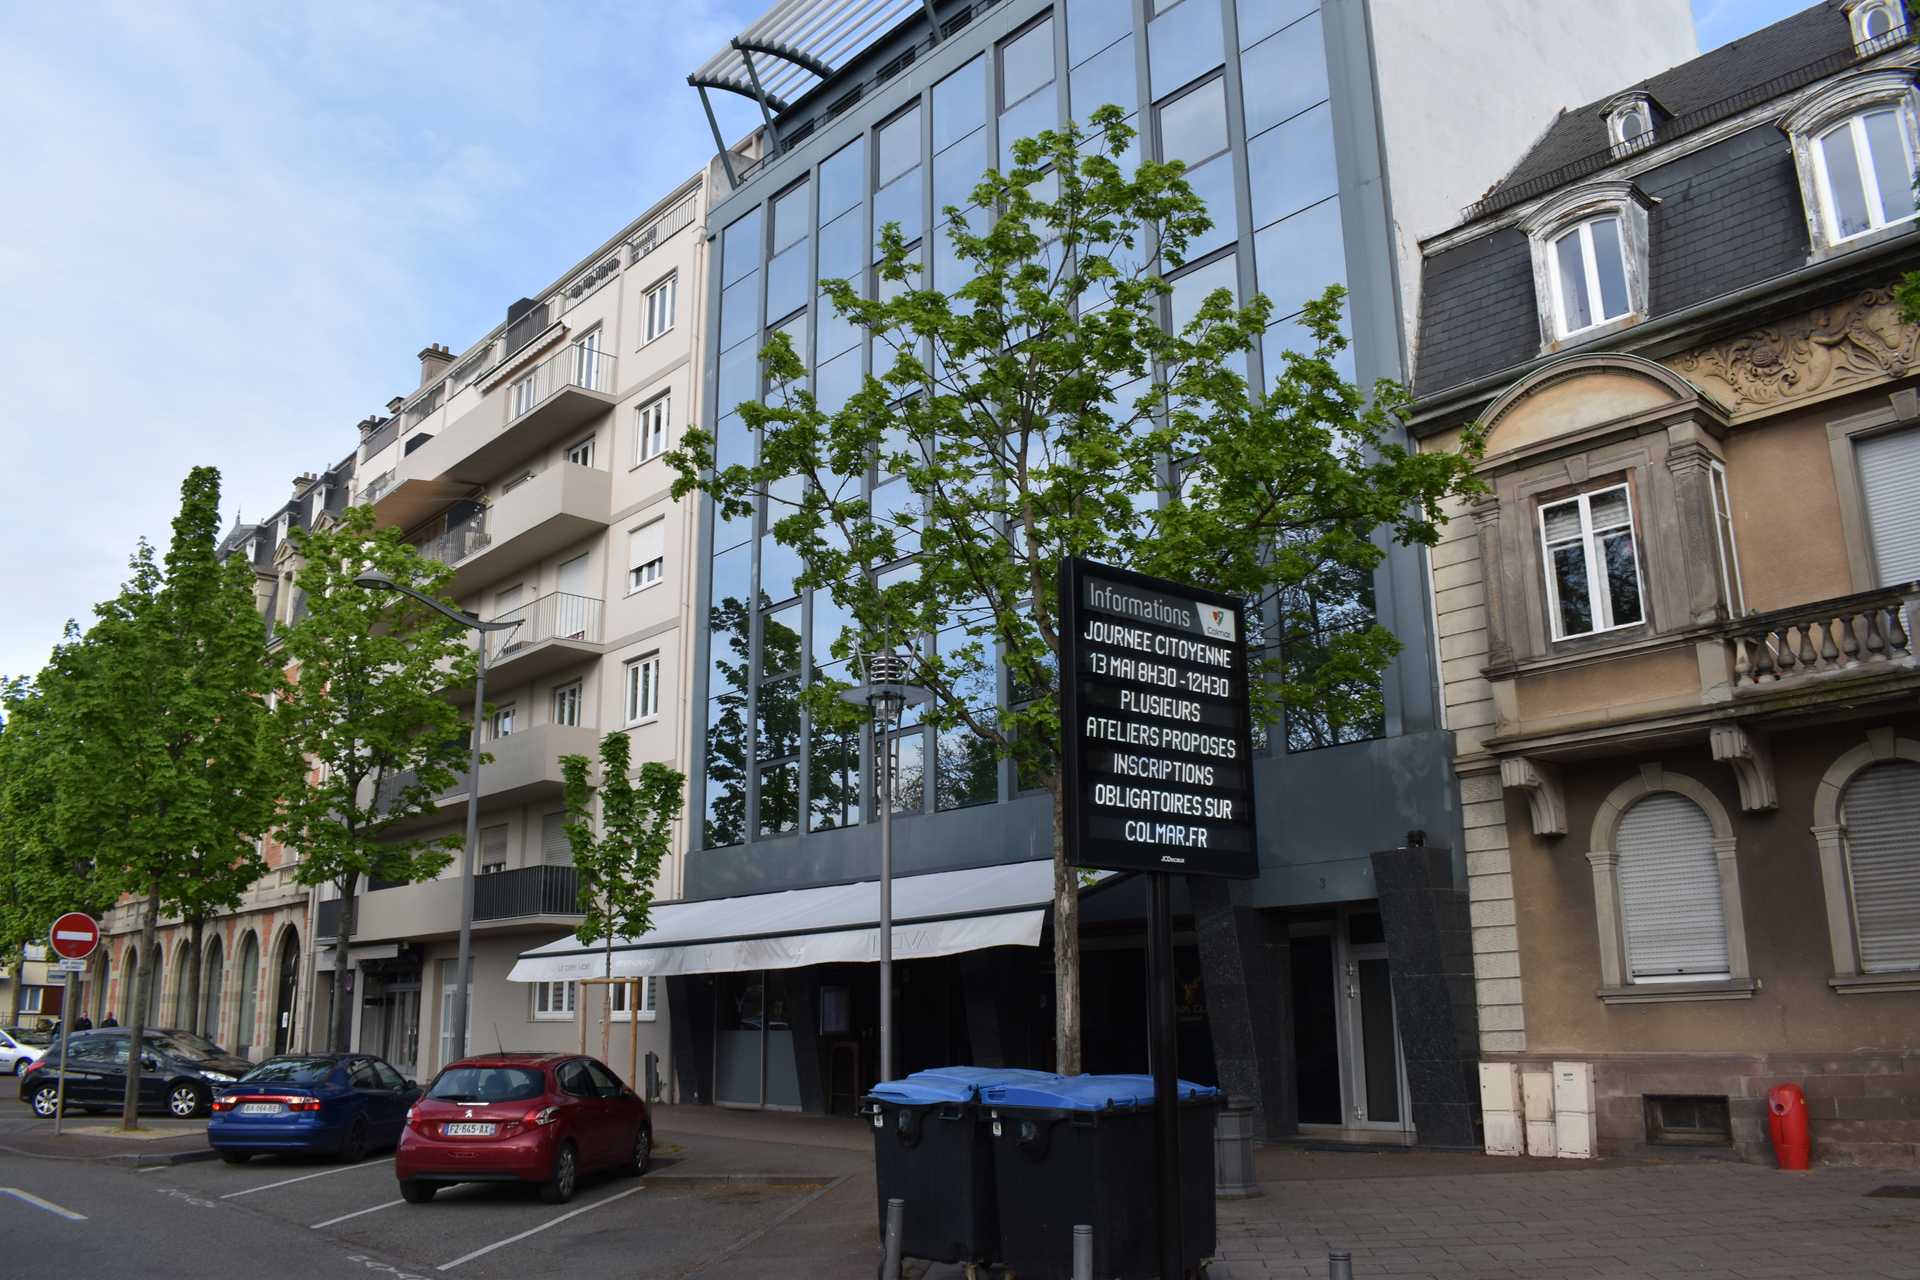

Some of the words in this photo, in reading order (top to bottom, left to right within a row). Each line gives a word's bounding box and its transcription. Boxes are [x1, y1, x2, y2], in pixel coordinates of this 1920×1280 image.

[1089, 582, 1192, 628] Informations
[1084, 620, 1152, 652] JOURNEE
[1155, 635, 1232, 669] CITOYENNE
[1089, 652, 1107, 674] 13
[1110, 657, 1135, 680] MAI
[1138, 662, 1177, 688] 8H30
[1120, 690, 1201, 722] PLUSIEURS
[1086, 716, 1159, 748] ATELIERS
[1162, 729, 1236, 759] PROPOSES
[1113, 753, 1214, 786] INSCRIPTIONS
[1095, 783, 1202, 817] OBLIGATOIRES
[1205, 799, 1232, 820] SUR
[1125, 820, 1208, 848] COLMAR.FR
